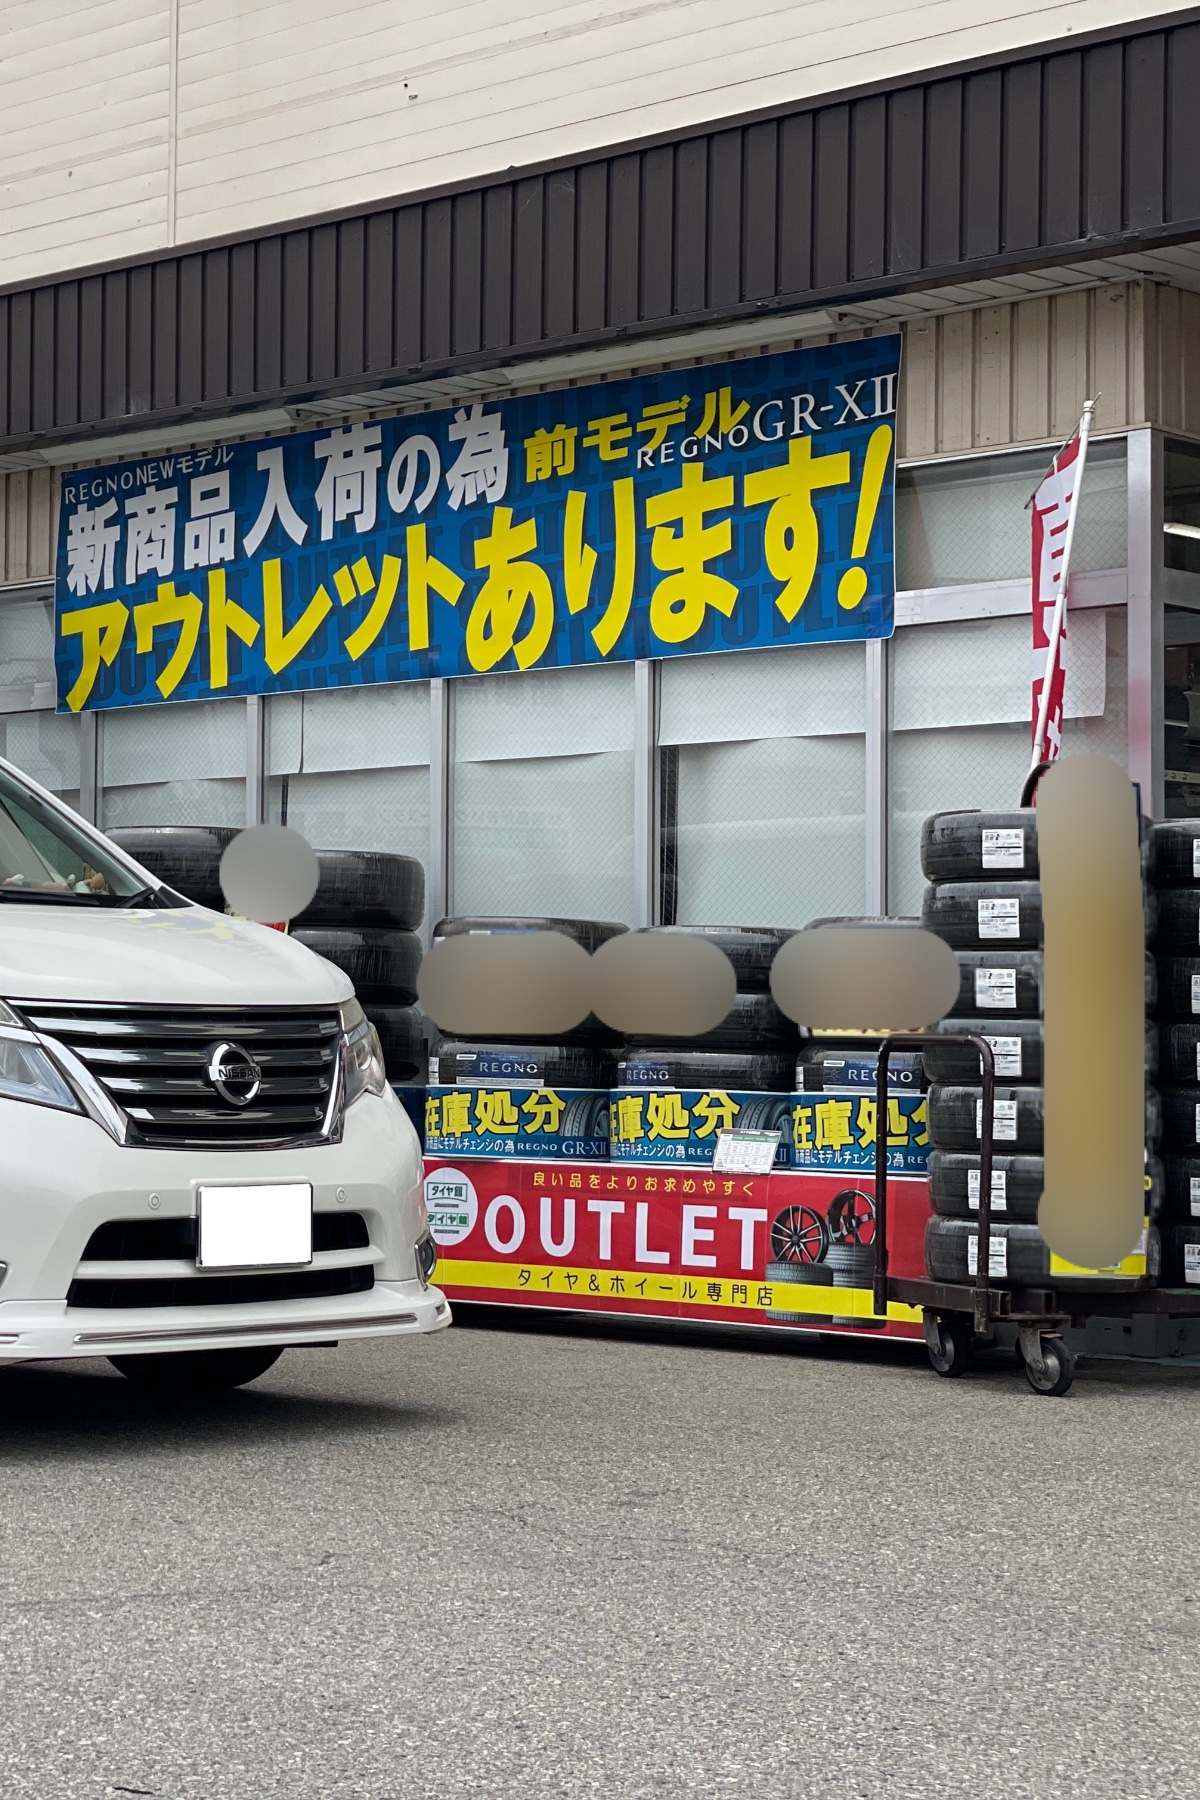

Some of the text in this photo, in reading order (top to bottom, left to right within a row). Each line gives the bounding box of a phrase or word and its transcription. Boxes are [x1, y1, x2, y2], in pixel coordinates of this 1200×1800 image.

[66, 403, 510, 596] 新商品入荷の為
[524, 386, 750, 482] 前モデル
[61, 424, 895, 712] アウトレットあります!
[218, 1067, 260, 1079] NISSAN
[479, 1062, 538, 1074] REGNO
[627, 1070, 669, 1081] REGNO
[425, 1089, 567, 1138] 在庫処分
[517, 1142, 557, 1151] REGNO
[432, 1185, 463, 1198] タイヤ館
[532, 1171, 755, 1195] 良い品をよりお求めやすく
[484, 1194, 768, 1271] OUTLET
[517, 1268, 774, 1306] タイヤ&ホイール専門店
